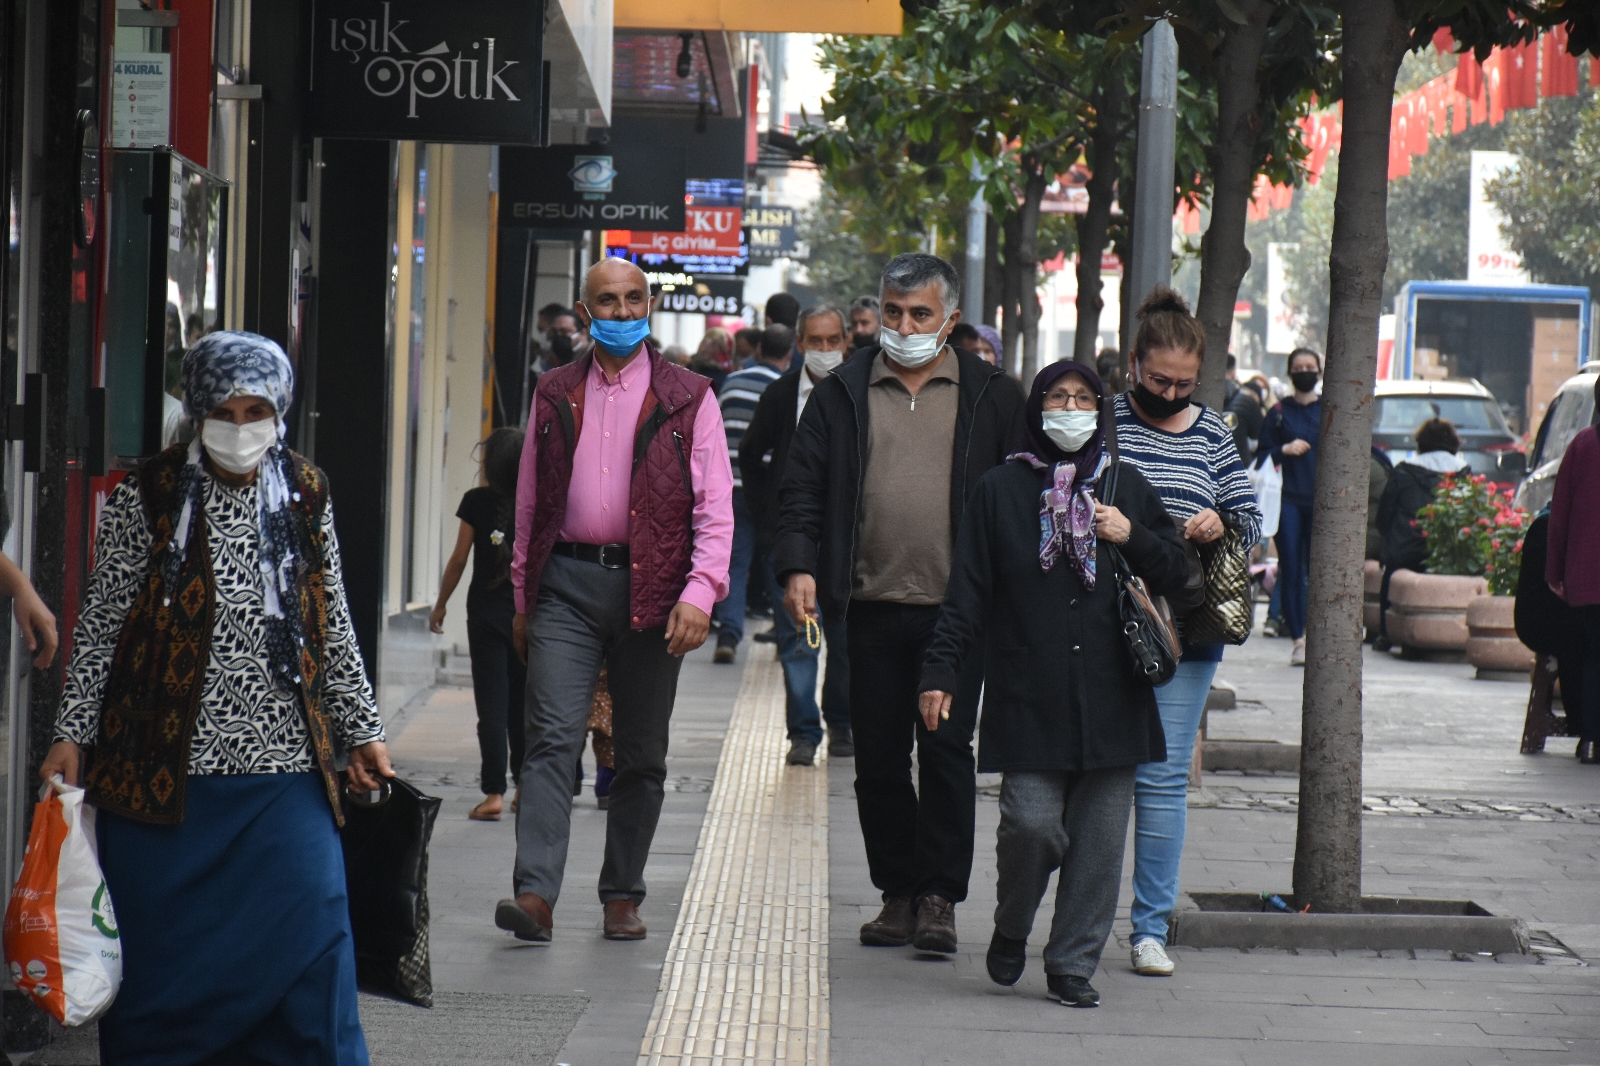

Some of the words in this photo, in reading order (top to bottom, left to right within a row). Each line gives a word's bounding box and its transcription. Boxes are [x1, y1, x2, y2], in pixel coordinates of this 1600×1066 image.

[329, 1, 411, 63] ışık
[114, 64, 122, 75] 4
[124, 64, 163, 75] KURAL
[513, 202, 594, 219] ERSUN
[600, 201, 669, 221] OPTİK
[652, 233, 669, 251] İÇ
[671, 234, 716, 250] GİYİM
[663, 293, 738, 314] TUDORS
